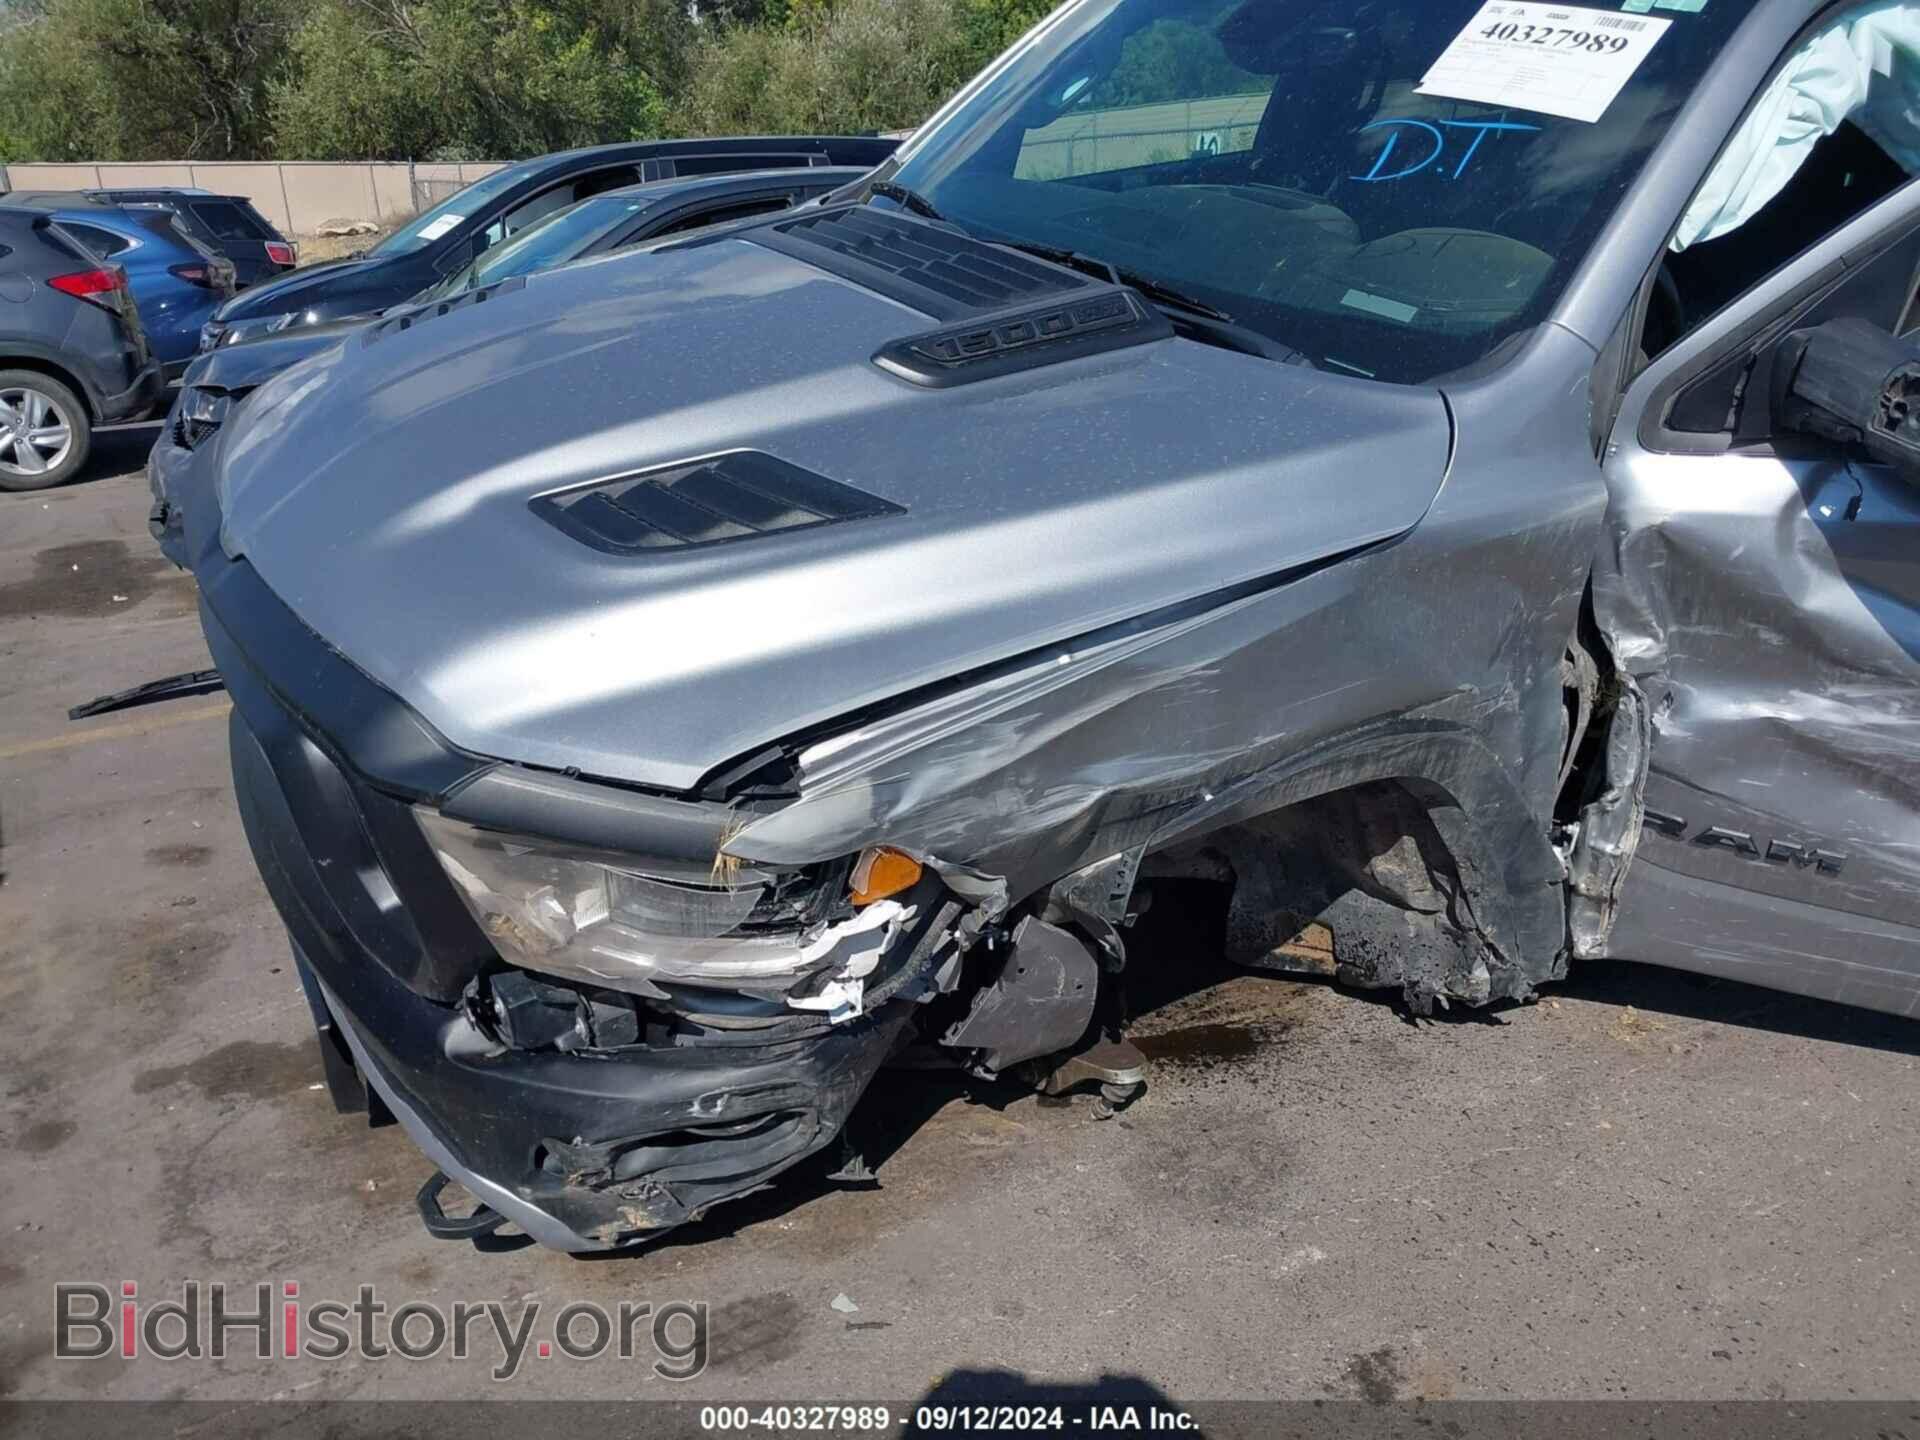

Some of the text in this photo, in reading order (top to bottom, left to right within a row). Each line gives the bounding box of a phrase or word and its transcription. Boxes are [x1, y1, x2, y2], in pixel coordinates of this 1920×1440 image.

[1480, 21, 1630, 56] 40327989
[934, 311, 1077, 359] 1500
[1643, 809, 1848, 878] RAM
